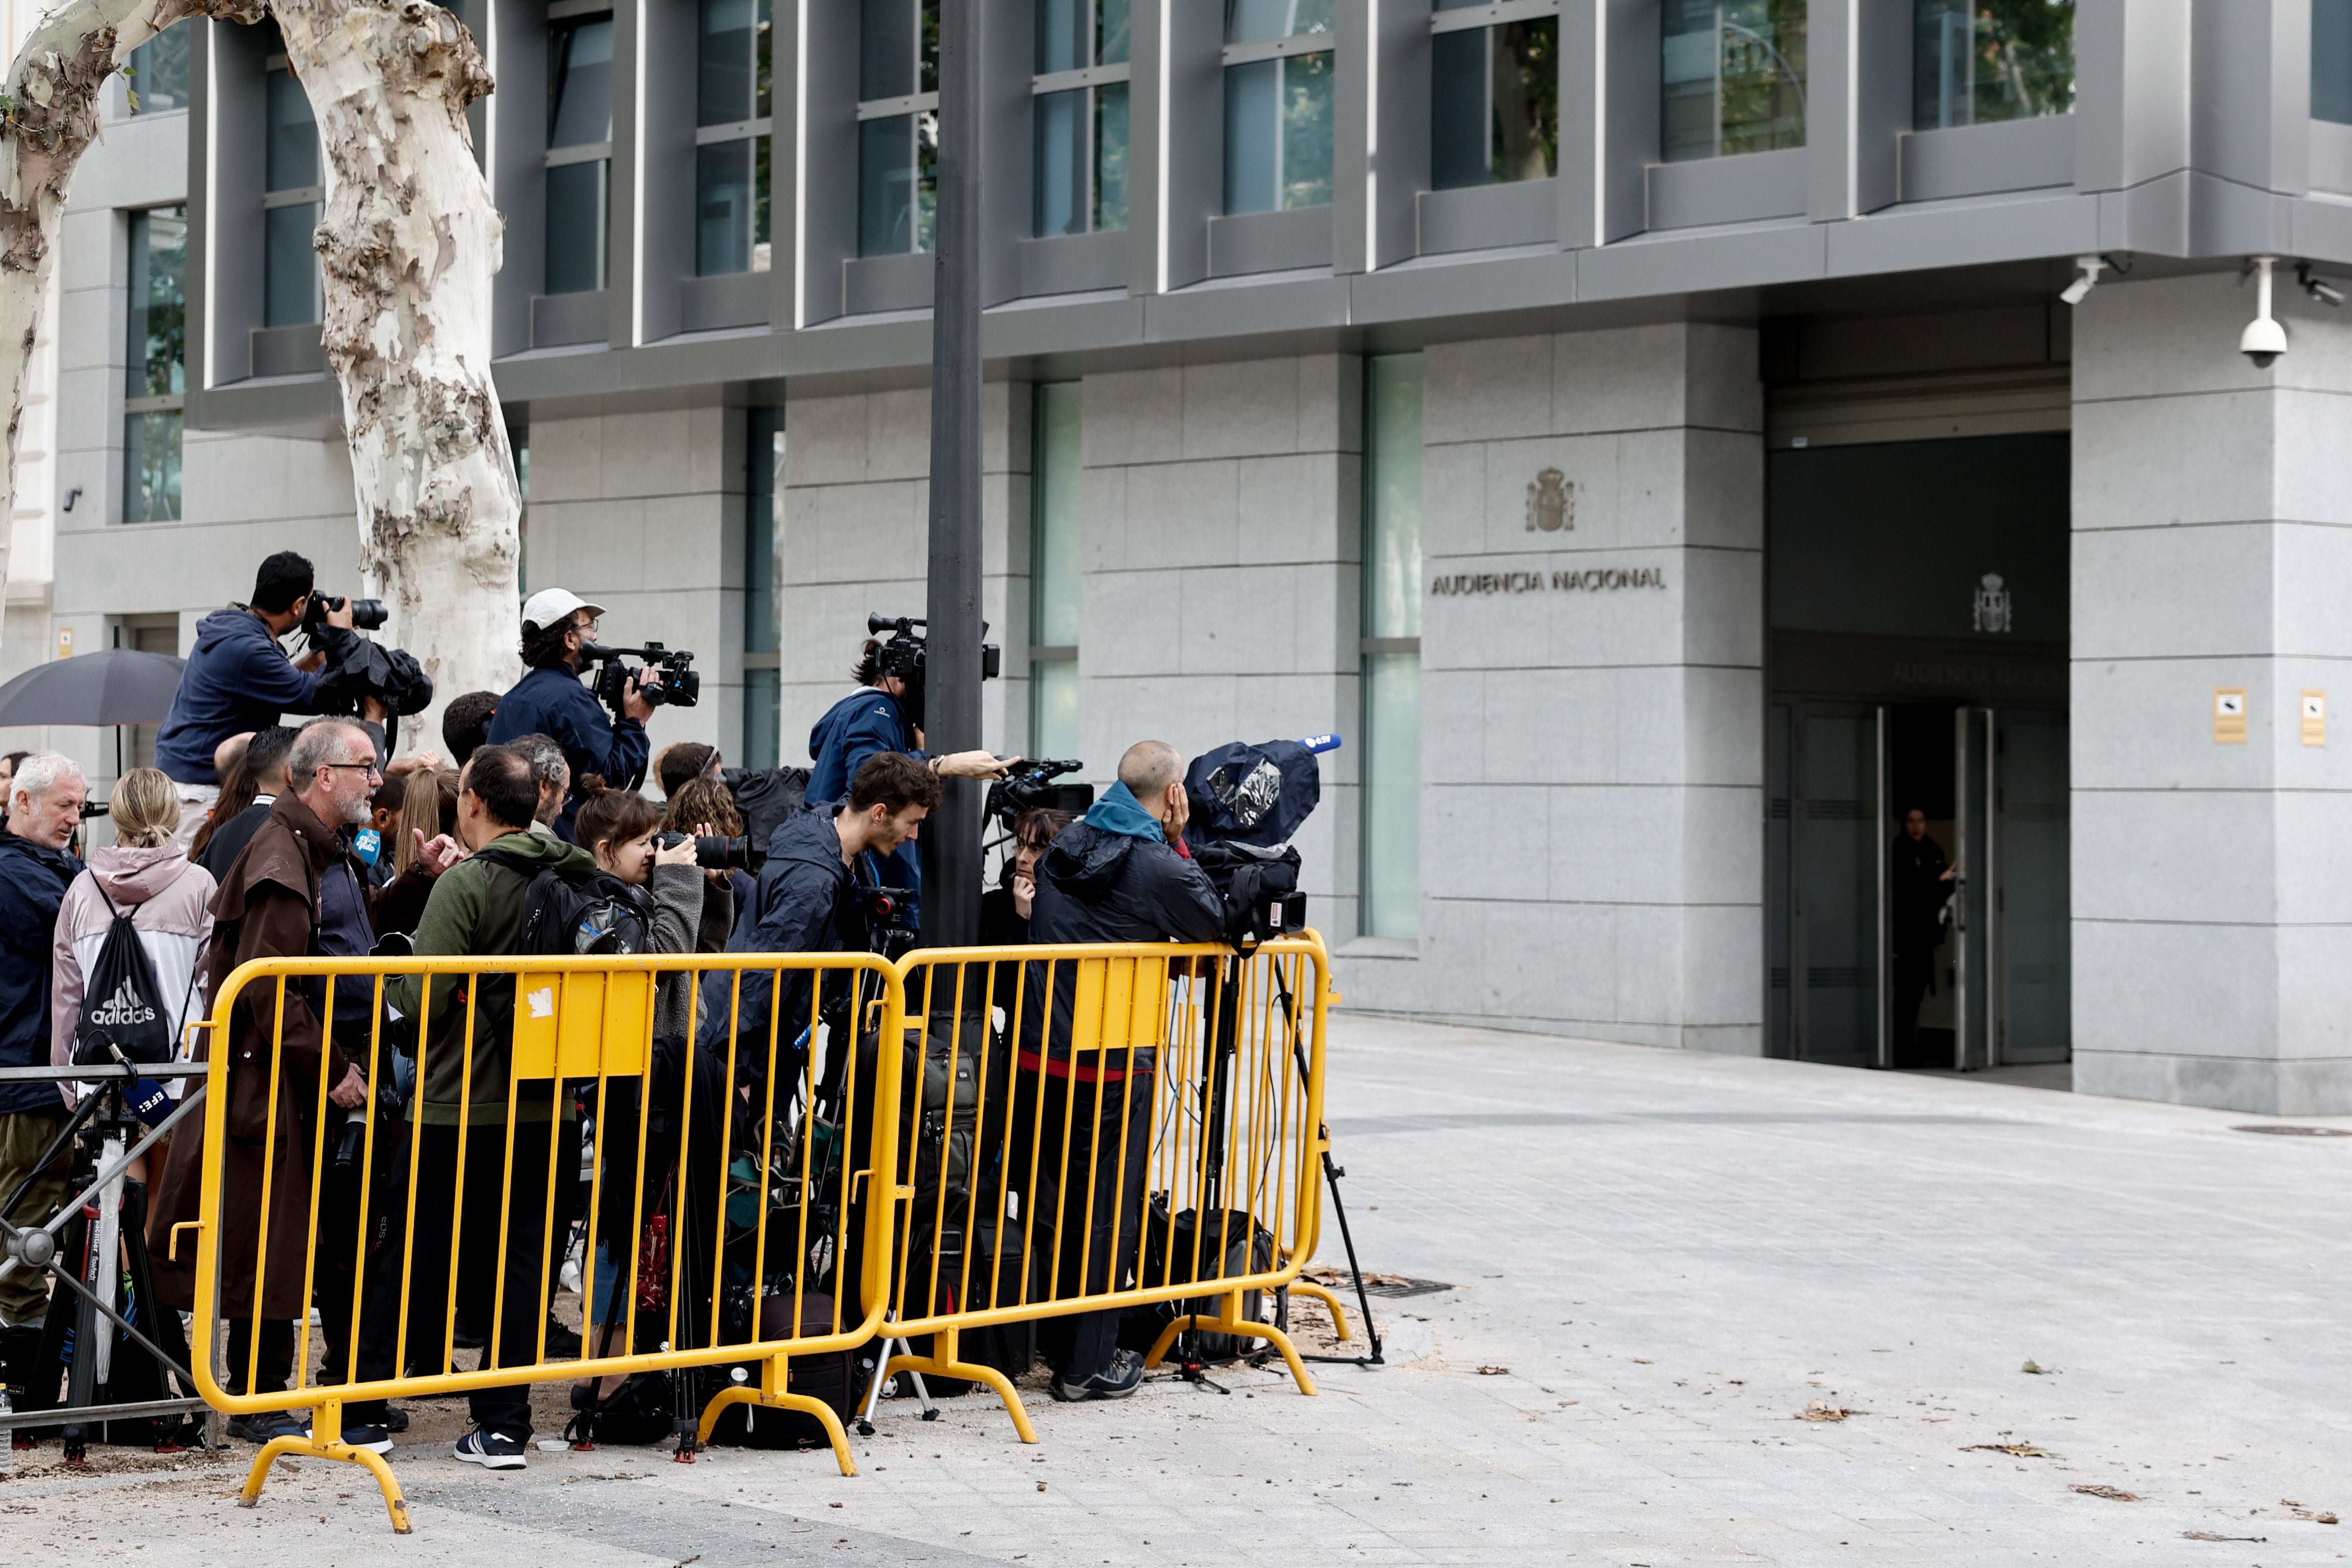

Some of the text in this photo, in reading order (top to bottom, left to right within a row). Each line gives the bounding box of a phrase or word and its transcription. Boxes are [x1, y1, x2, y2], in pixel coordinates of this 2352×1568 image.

[1431, 567, 1666, 596] AUDIENCIA NACIONAL
[356, 840, 375, 852] Vida
[91, 1006, 156, 1026] adidas
